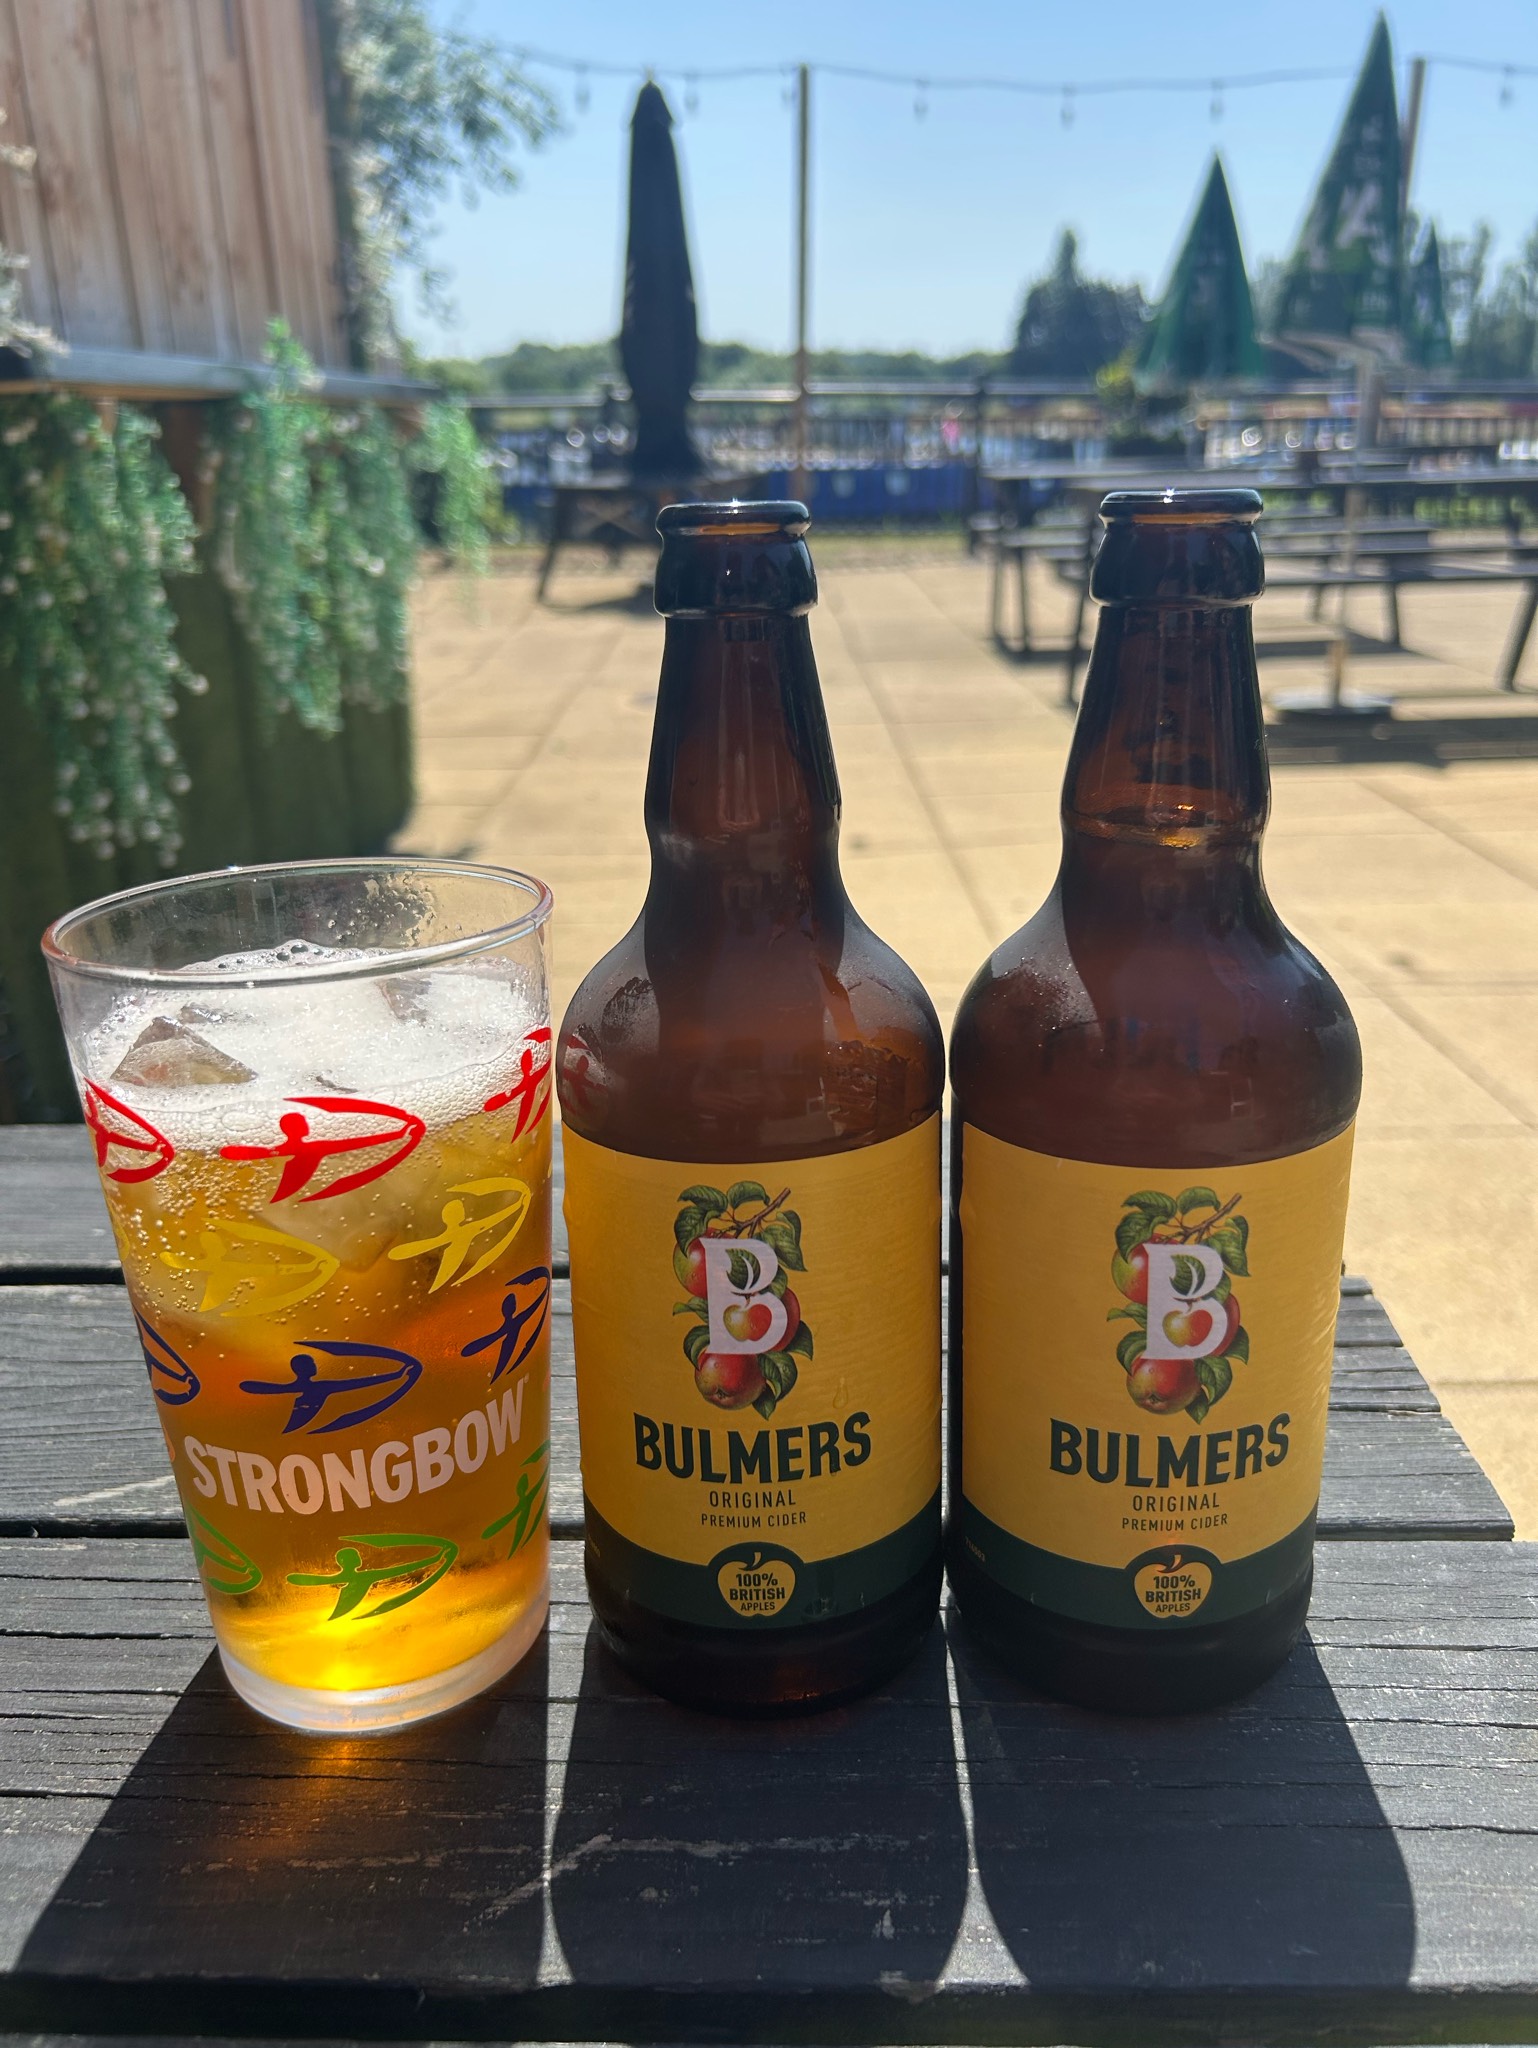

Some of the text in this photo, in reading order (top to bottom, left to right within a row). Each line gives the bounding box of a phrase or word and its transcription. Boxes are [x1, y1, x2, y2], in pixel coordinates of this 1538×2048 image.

[183, 1378, 524, 1515] STRONGBOW
[633, 1411, 872, 1484] BULMERS
[1049, 1412, 1291, 1488] BULMERS
[709, 1489, 796, 1509] ORIGINAL
[1132, 1492, 1220, 1512] ORIGINAL
[701, 1511, 807, 1528] PREMIUM CIDER
[1122, 1513, 1228, 1531] PREMIUM CIDER
[735, 1572, 778, 1587] 100%
[1153, 1574, 1196, 1589] 100%
[729, 1587, 785, 1601] BRITISH
[1145, 1588, 1201, 1603] BRITISH
[740, 1601, 776, 1611] APPLES
[1155, 1602, 1191, 1613] APPLES
